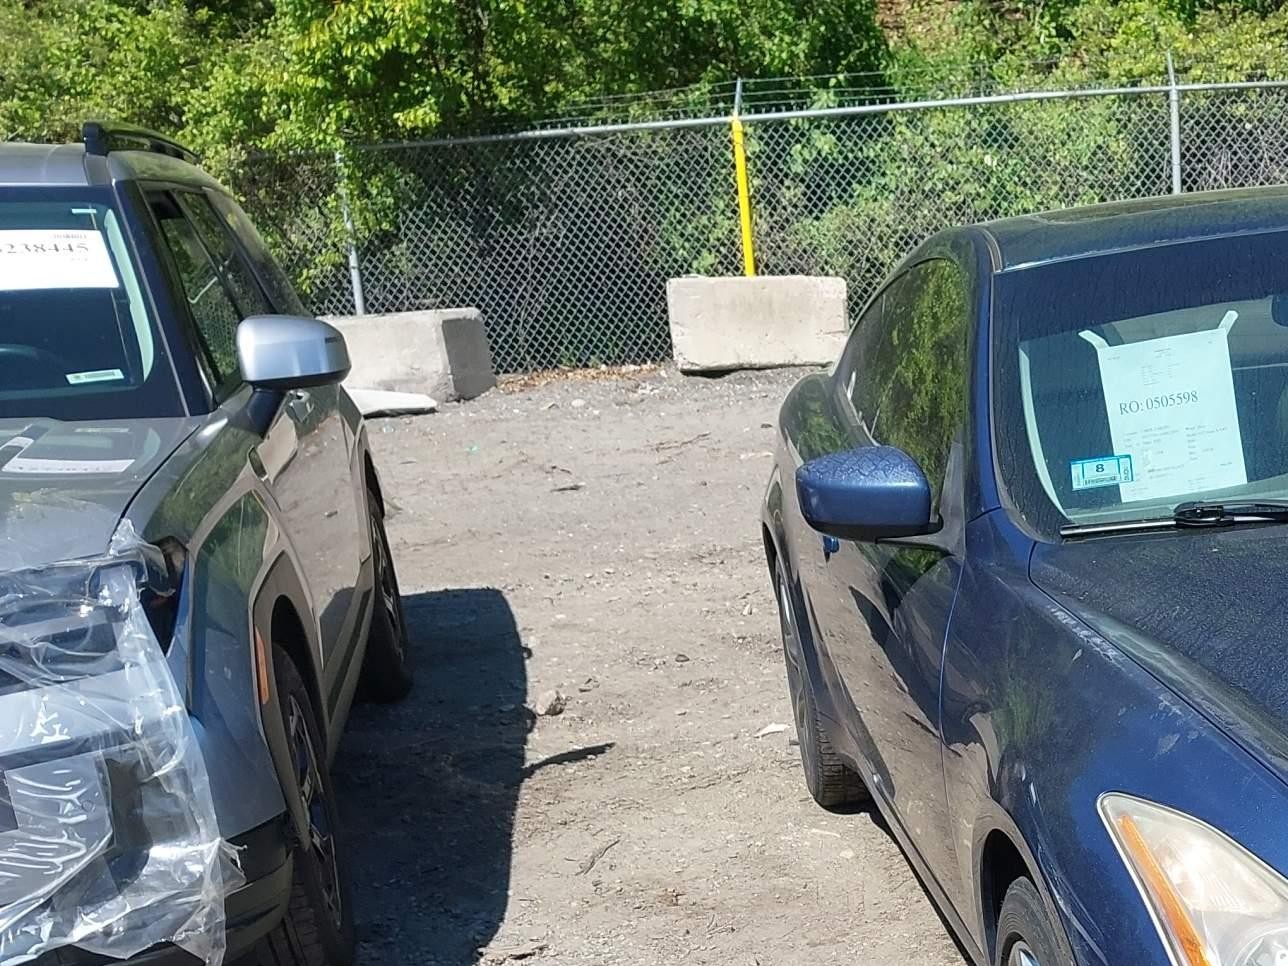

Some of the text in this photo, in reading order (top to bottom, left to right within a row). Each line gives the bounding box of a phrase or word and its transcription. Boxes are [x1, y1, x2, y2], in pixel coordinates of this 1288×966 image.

[0, 243, 89, 254] 238445
[1119, 390, 1199, 416] RO: 0505598
[1095, 463, 1105, 473] 8
